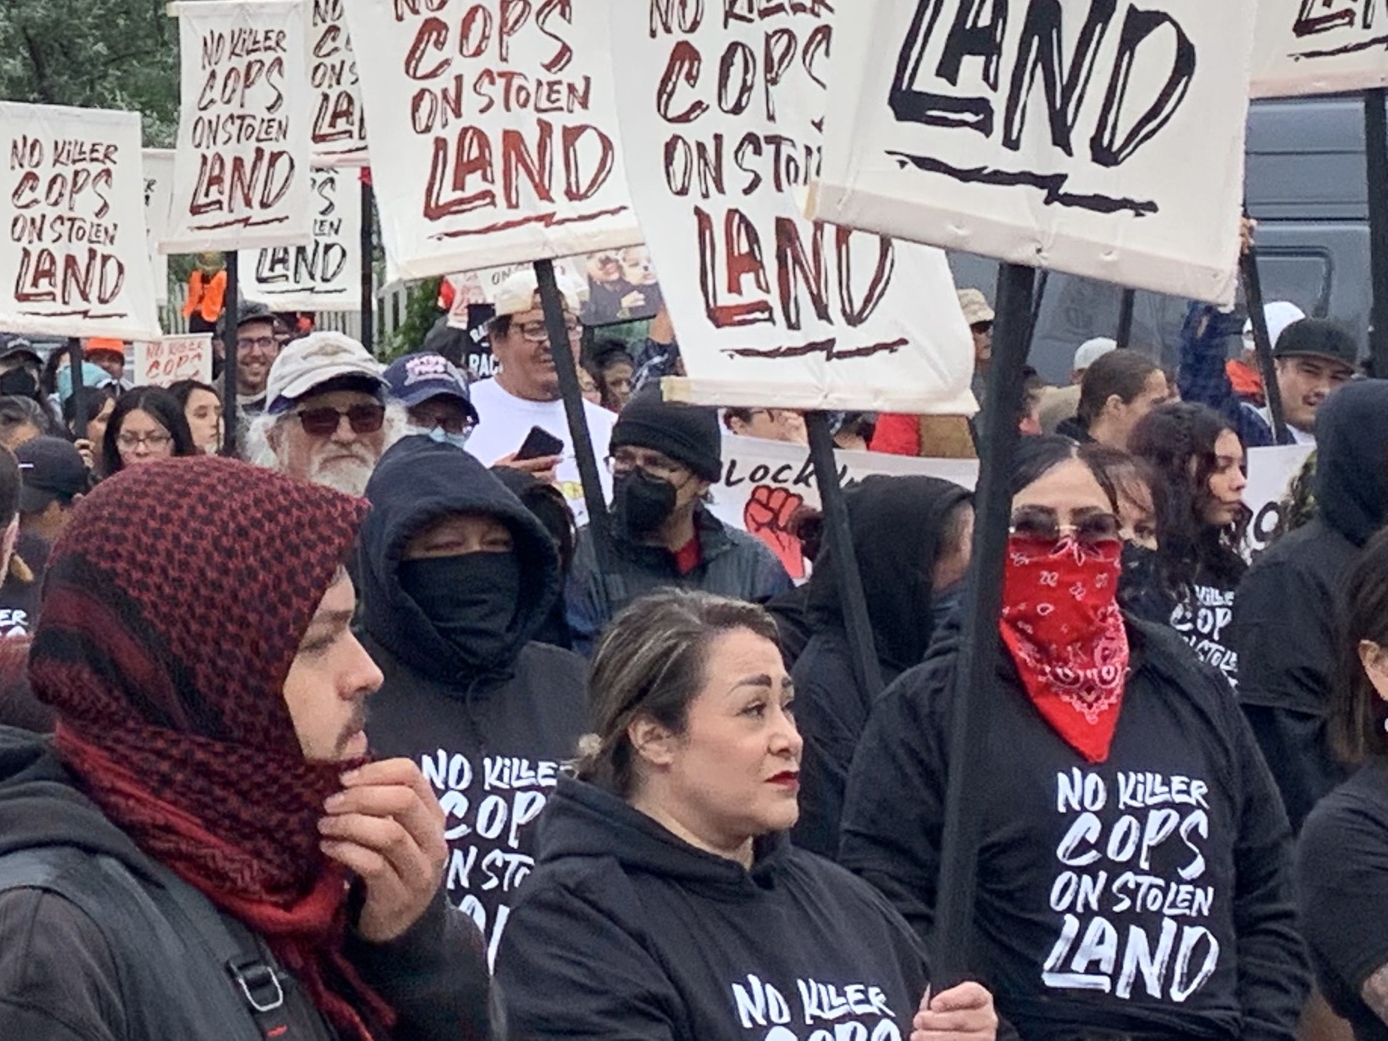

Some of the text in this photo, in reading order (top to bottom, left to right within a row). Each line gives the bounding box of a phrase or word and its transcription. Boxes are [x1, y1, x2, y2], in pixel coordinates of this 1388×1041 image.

[202, 29, 226, 70] NO
[312, 60, 345, 89] ON
[197, 56, 285, 113] COPS
[411, 68, 591, 134] ON STOLEN
[192, 114, 288, 148] ON STOLEN
[312, 90, 366, 144] LA
[11, 134, 44, 170] NO
[423, 118, 614, 221] LAND
[664, 133, 726, 199] ON
[12, 168, 113, 219] COPS
[189, 147, 295, 216] LAND
[11, 213, 118, 245] ON STOLEN
[14, 247, 124, 305] LAND
[255, 240, 347, 284] LAND
[694, 205, 895, 330] LAND
[1170, 603, 1232, 641] COP
[421, 749, 472, 790] NO
[1056, 766, 1107, 813] NO
[439, 790, 546, 849] COP
[1056, 809, 1209, 880] COPS
[1049, 870, 1214, 917] ON STOLEN
[1041, 913, 1220, 1003] LAND
[732, 974, 791, 1028] NO
